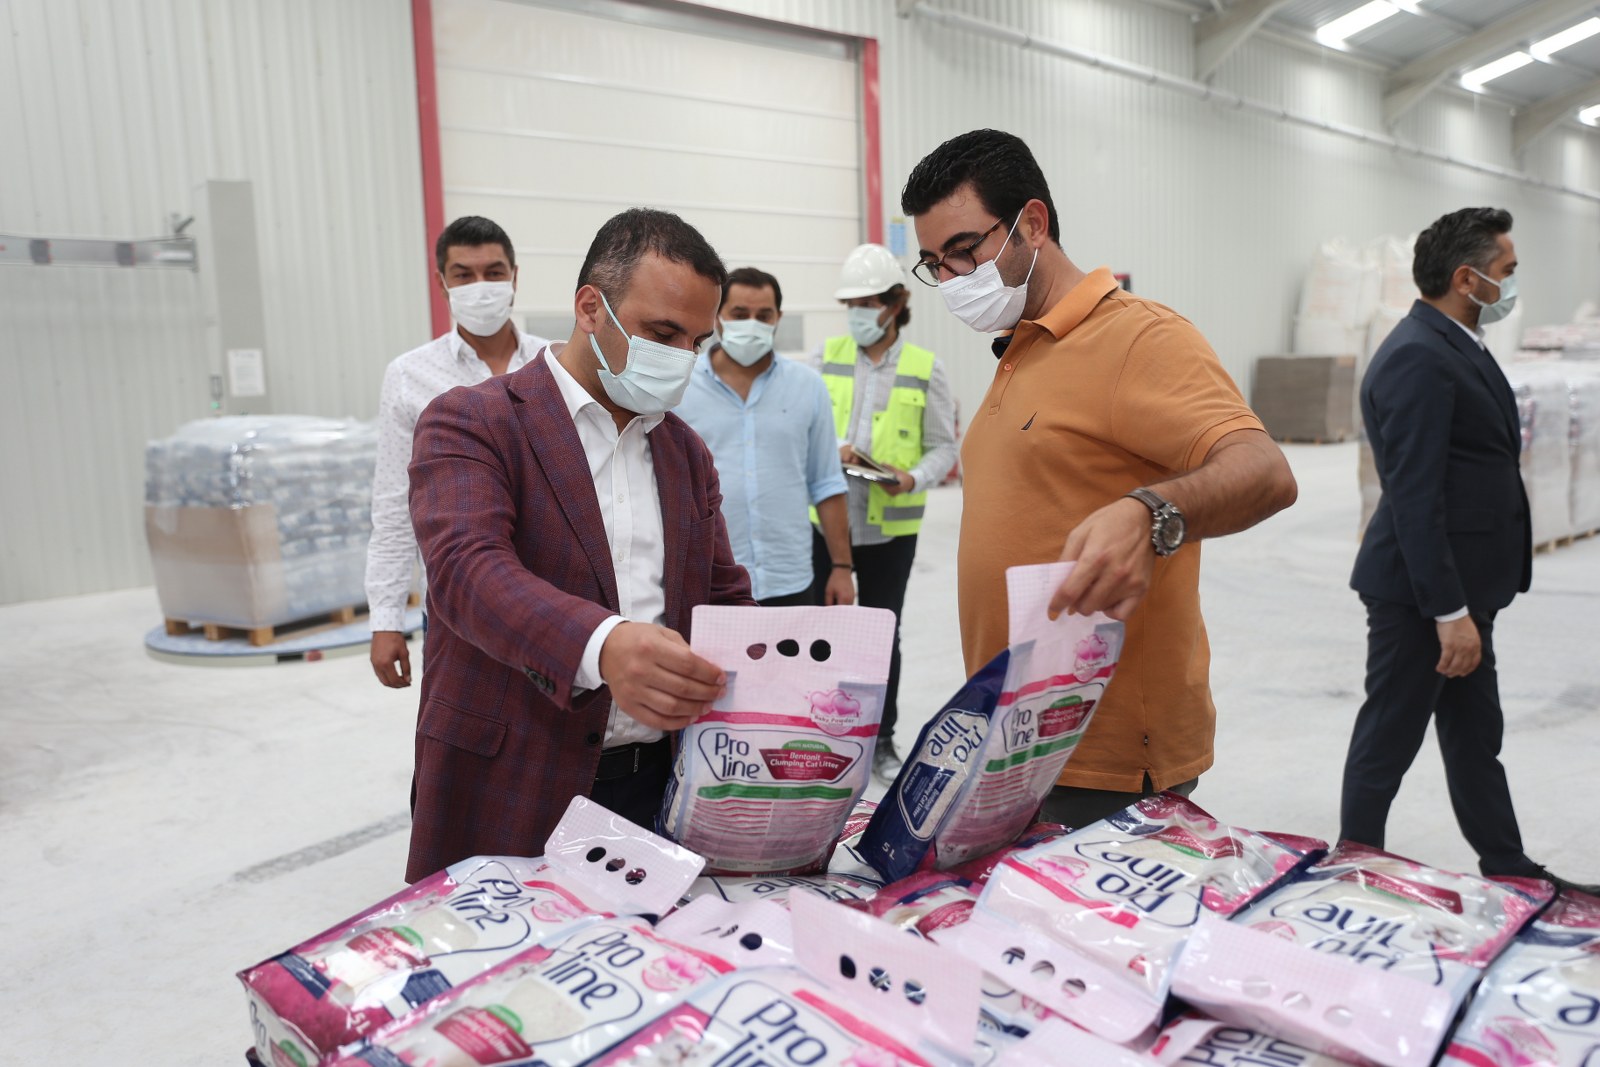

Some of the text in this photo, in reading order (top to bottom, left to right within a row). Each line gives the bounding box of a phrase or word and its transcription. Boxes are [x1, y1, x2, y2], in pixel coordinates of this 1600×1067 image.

[715, 732, 750, 756] Pro
[927, 715, 970, 756] line
[953, 724, 983, 763] Pro
[721, 754, 760, 779] line
[770, 758, 839, 769] Clumping Cat Litter
[789, 752, 821, 761] Bentonit
[1101, 852, 1186, 892] line
[479, 879, 536, 908] Pro
[1096, 873, 1175, 913] Pro
[577, 931, 645, 968] Pro
[541, 951, 618, 1011] line
[740, 999, 828, 1066] Pro
[1181, 1026, 1255, 1067] Pro
